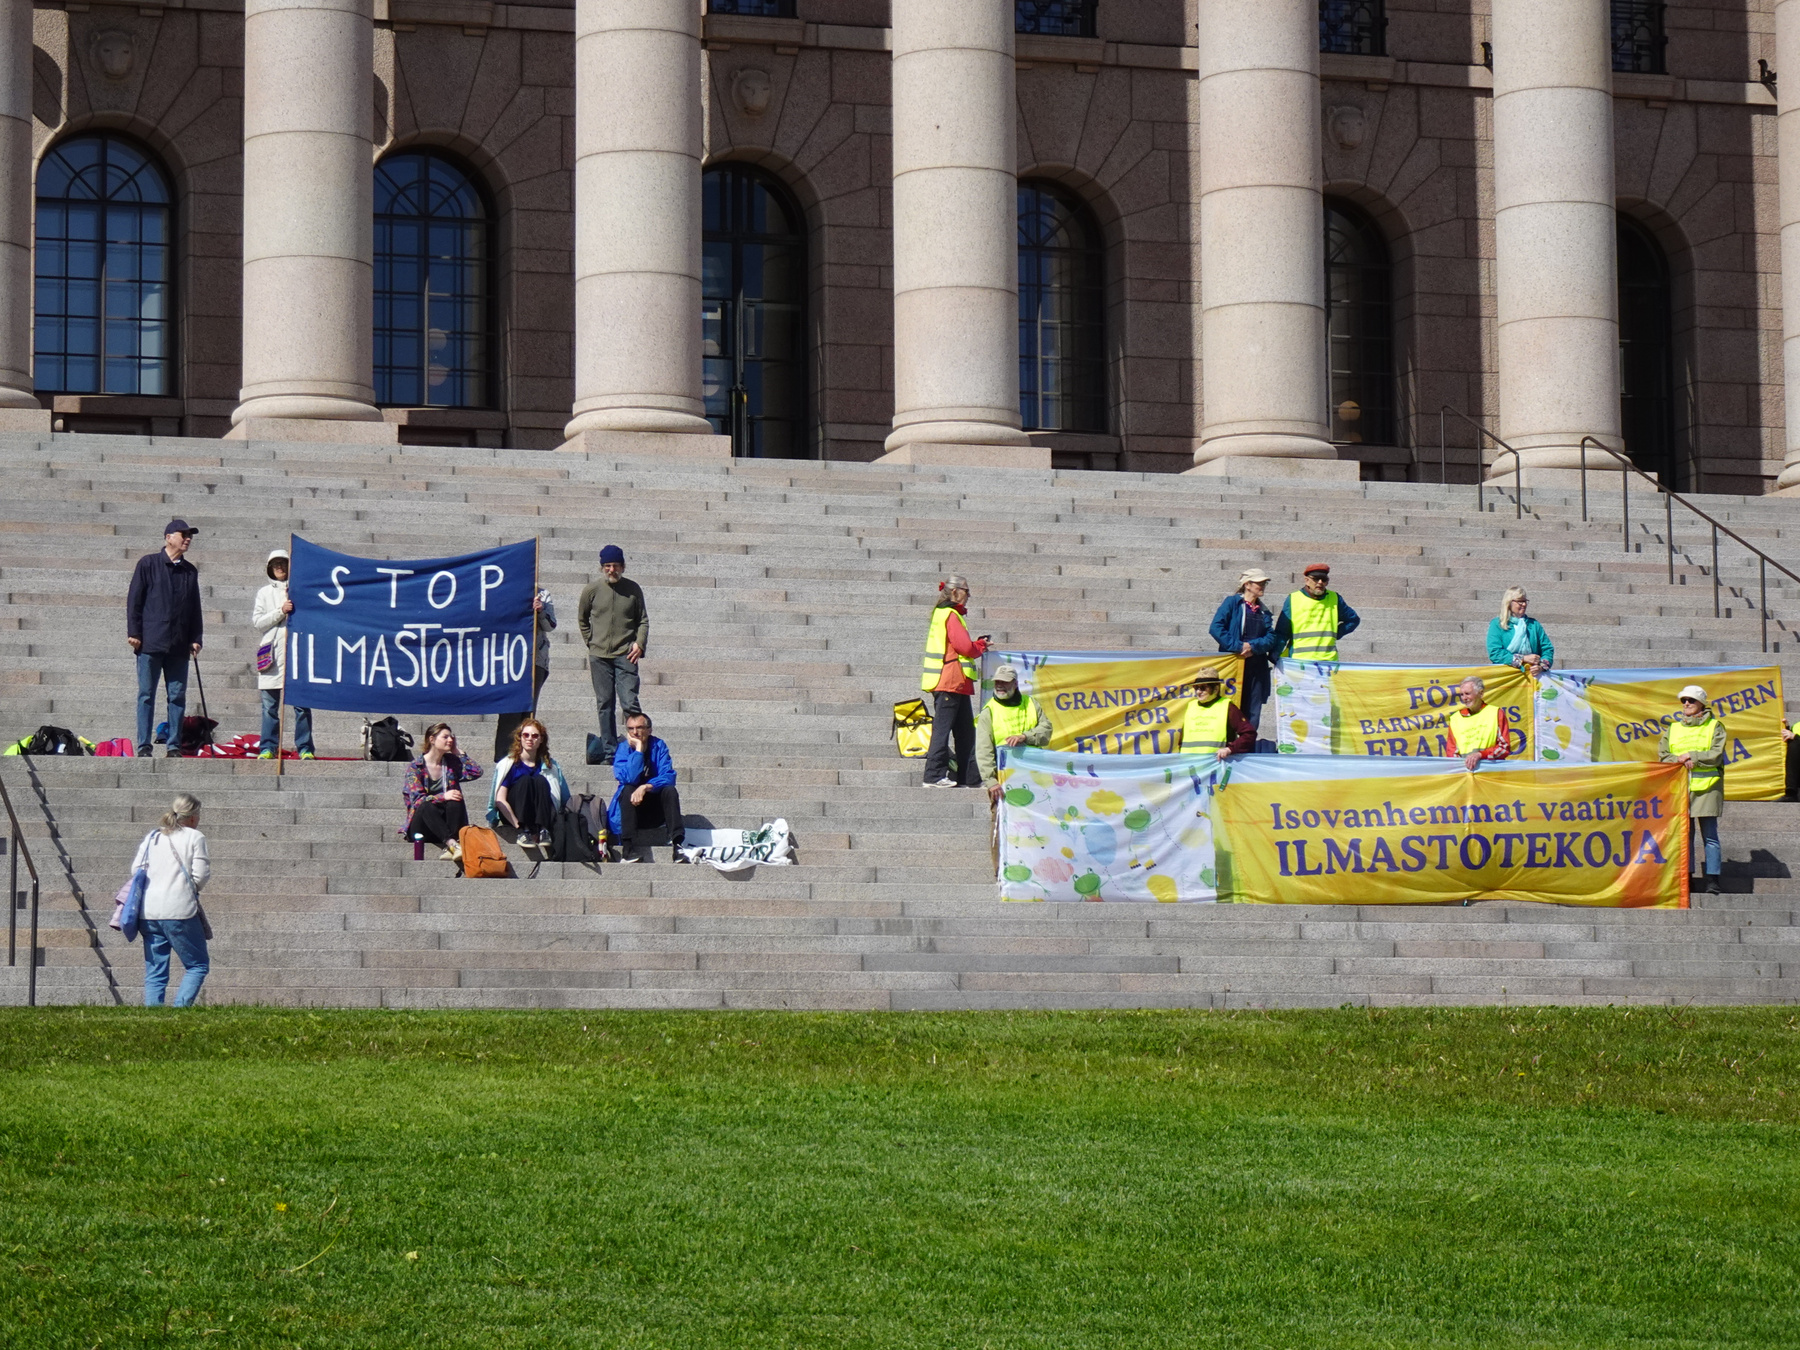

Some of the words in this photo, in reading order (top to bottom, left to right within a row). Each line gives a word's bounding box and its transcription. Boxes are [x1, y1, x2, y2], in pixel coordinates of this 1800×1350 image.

[318, 565, 504, 611] STOP
[292, 624, 528, 688] ILMASTOTUHO
[1055, 678, 1237, 711] GRANDPARES
[1125, 707, 1170, 727] FOR
[1270, 799, 1527, 831] Isovanhemmat
[1538, 793, 1663, 822] vaativat
[1275, 829, 1667, 876] ILMASTOTEKOJA
